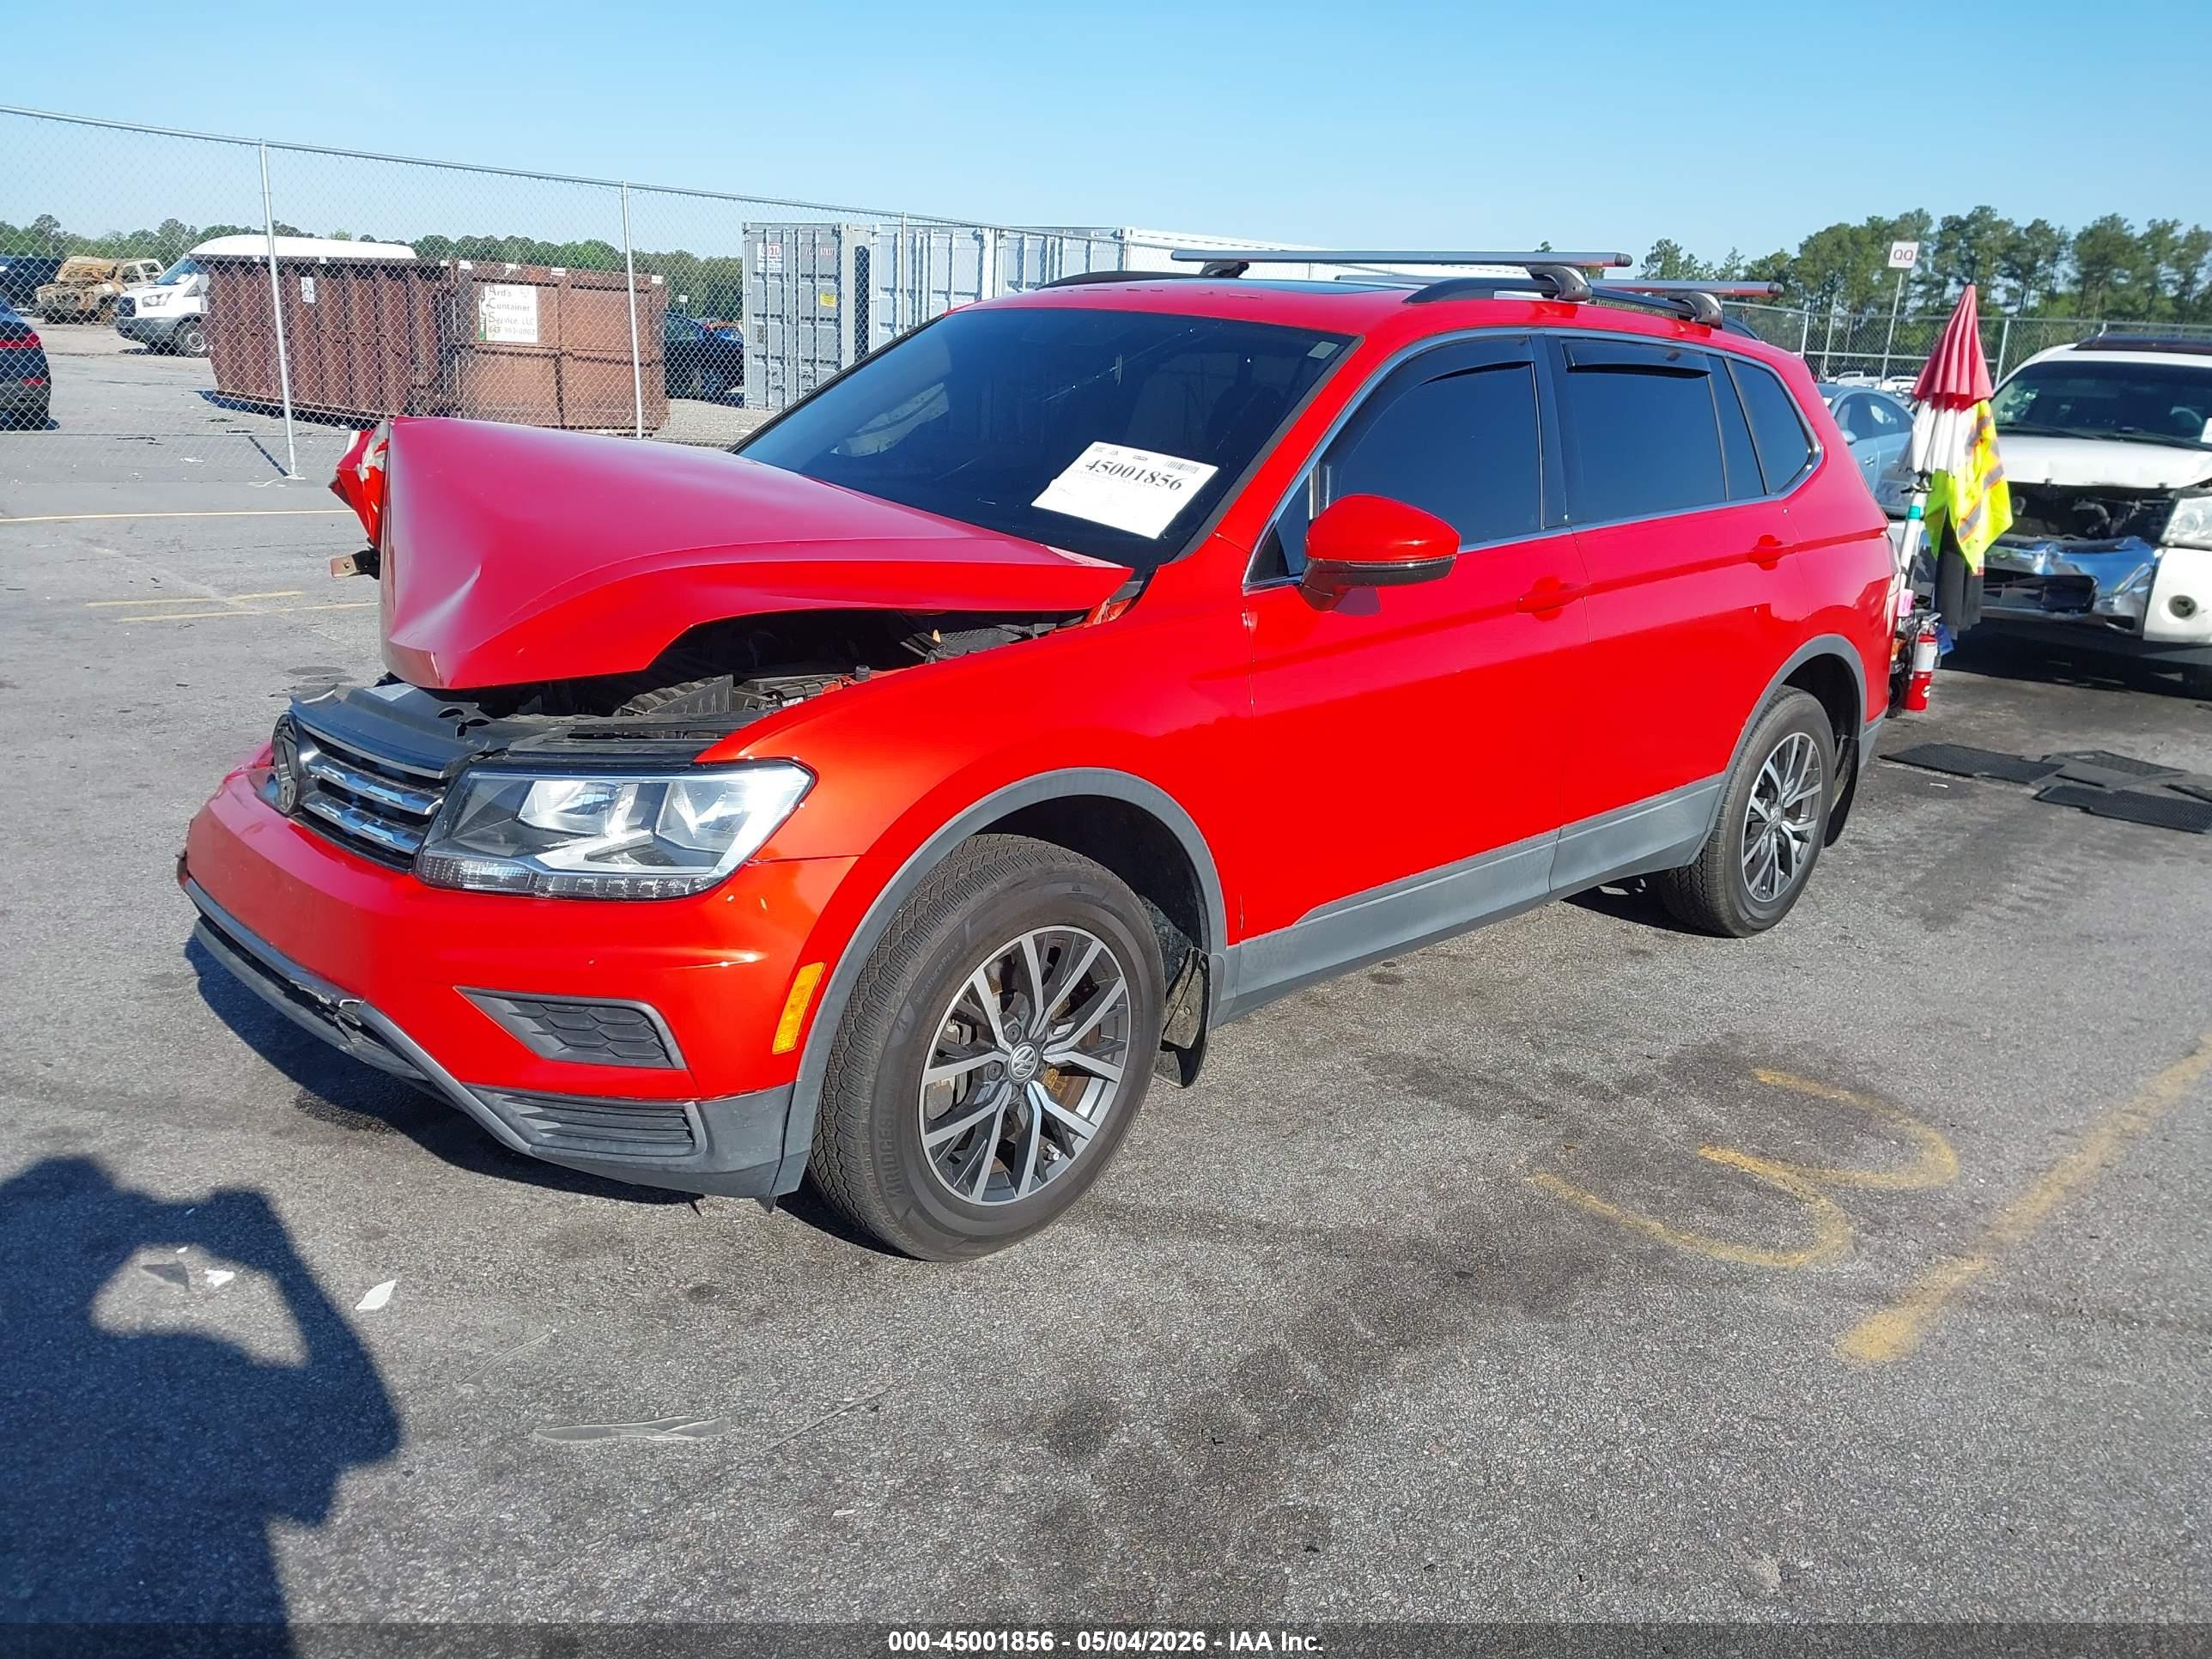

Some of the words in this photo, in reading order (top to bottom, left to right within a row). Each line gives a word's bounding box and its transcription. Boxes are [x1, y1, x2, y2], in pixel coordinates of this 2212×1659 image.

[488, 298, 530, 311] Container
[488, 312, 519, 325] Service
[1085, 459, 1188, 491] 45001856
